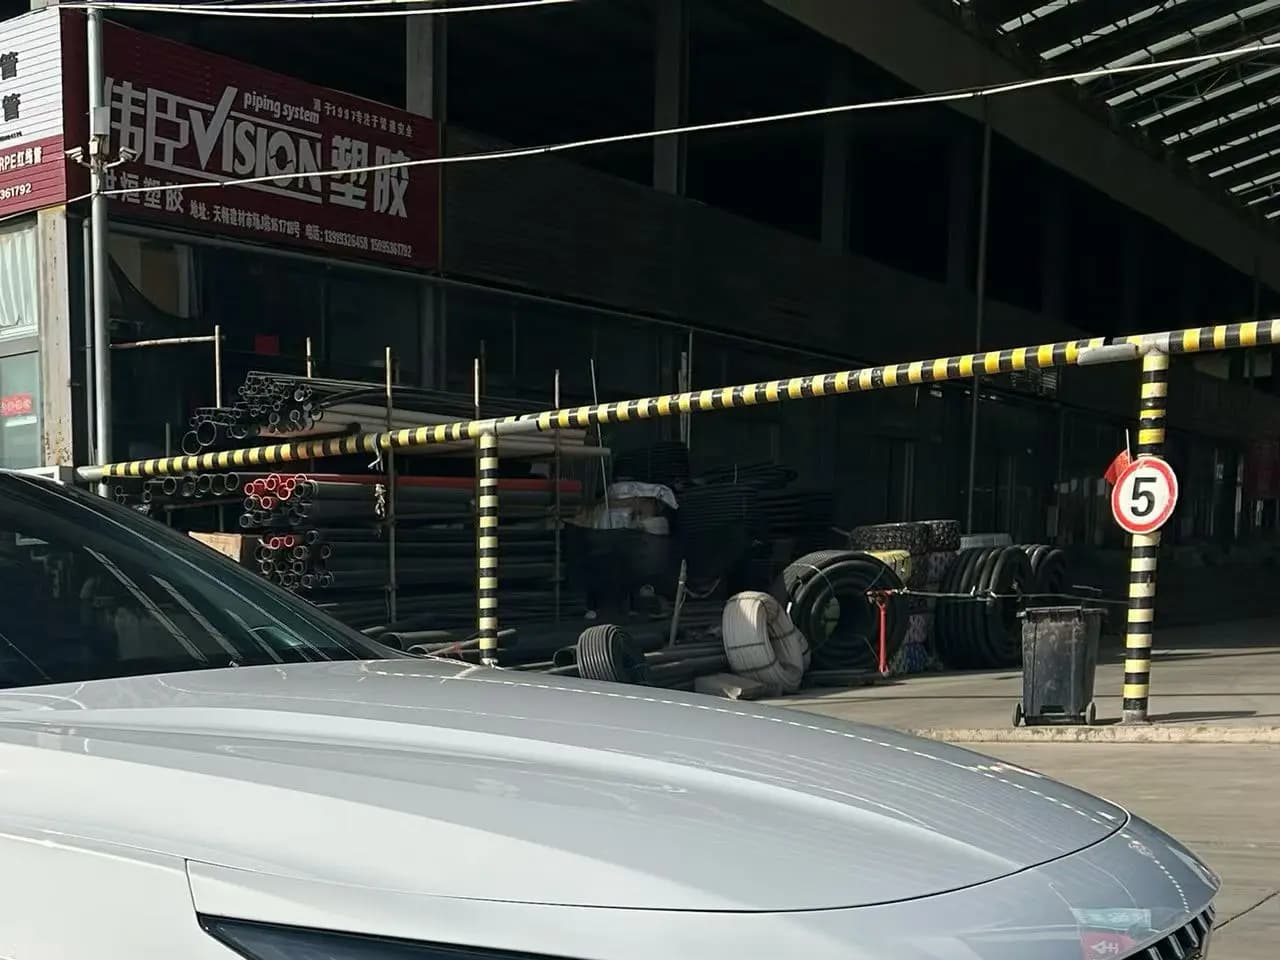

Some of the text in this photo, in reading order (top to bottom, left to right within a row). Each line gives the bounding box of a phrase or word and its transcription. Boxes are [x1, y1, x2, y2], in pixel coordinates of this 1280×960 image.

[243, 91, 320, 125] piping system
[189, 86, 322, 192] VISION
[329, 135, 410, 218] 塑胶
[1131, 477, 1158, 517] 5
